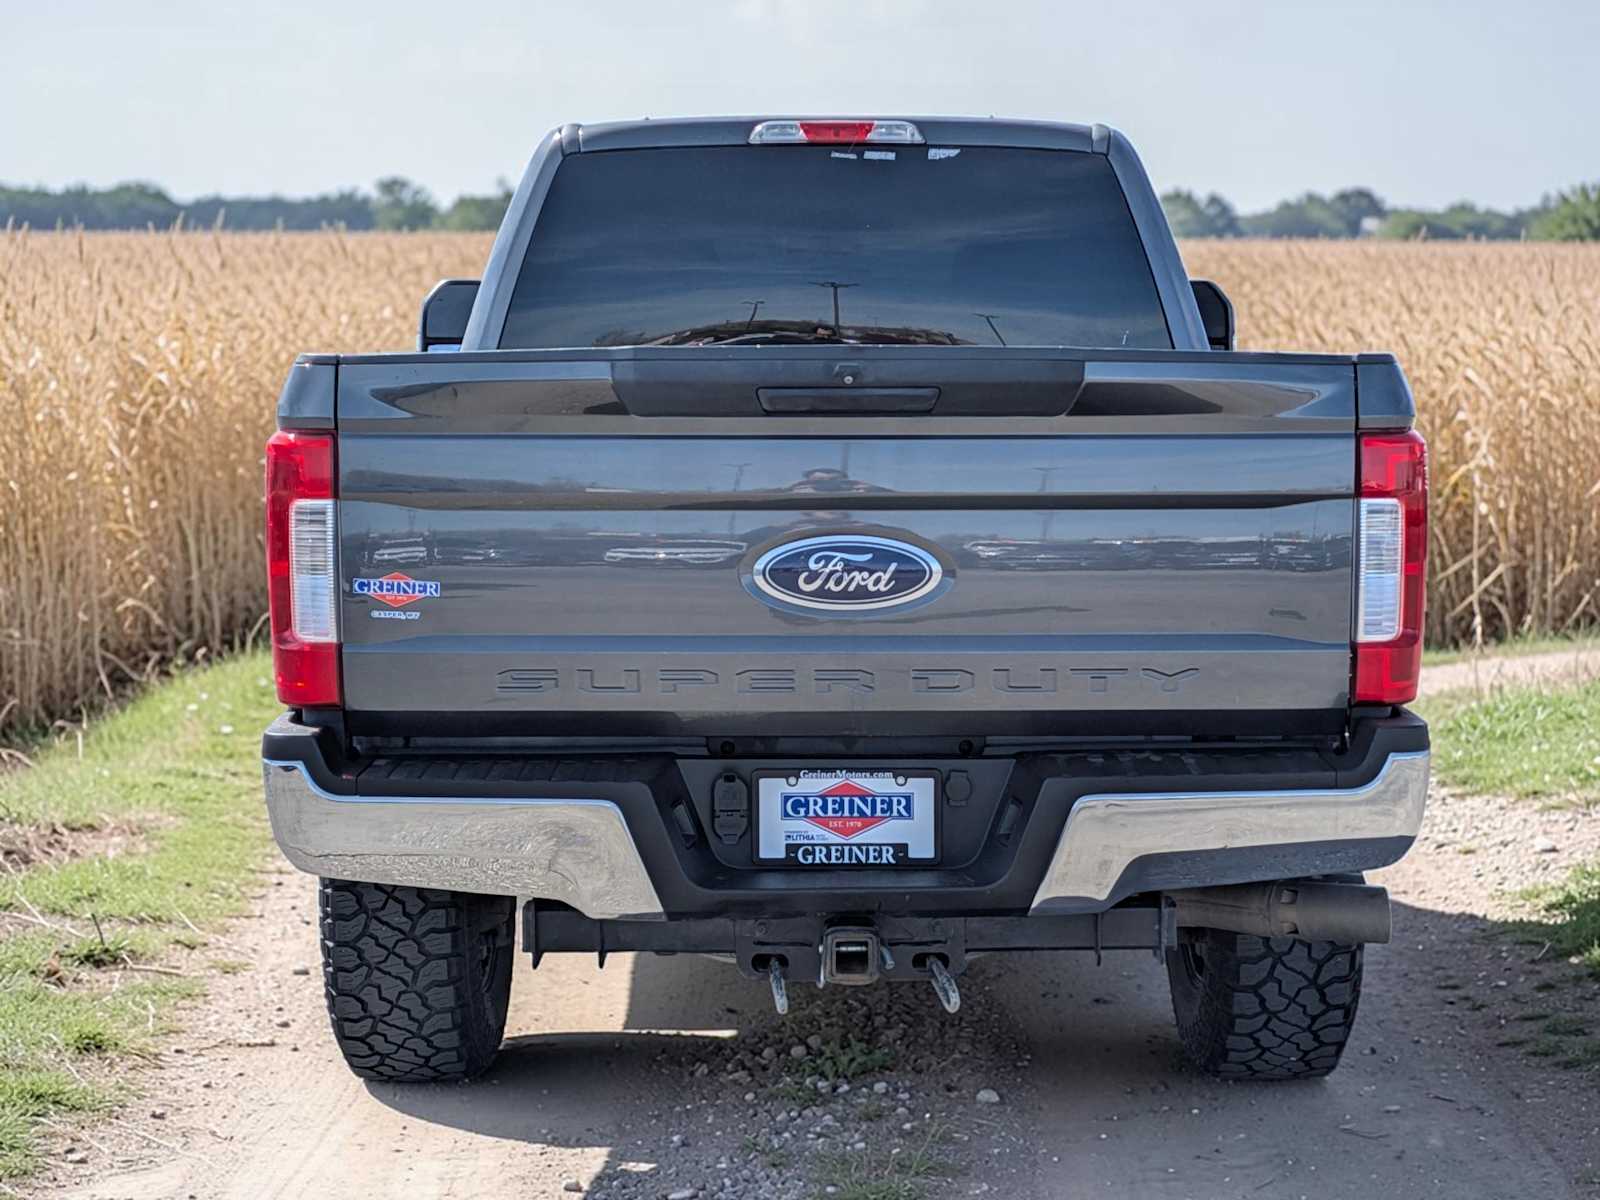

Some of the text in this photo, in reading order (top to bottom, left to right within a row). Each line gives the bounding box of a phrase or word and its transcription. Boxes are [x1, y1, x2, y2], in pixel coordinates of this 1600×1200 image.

[798, 551, 898, 592] Ford
[354, 579, 438, 597] GREINER
[496, 667, 1200, 692] SUPER DUTY
[800, 769, 894, 779] GreinerMotors.com
[786, 796, 910, 817] GREINER
[797, 845, 897, 864] GREINER
